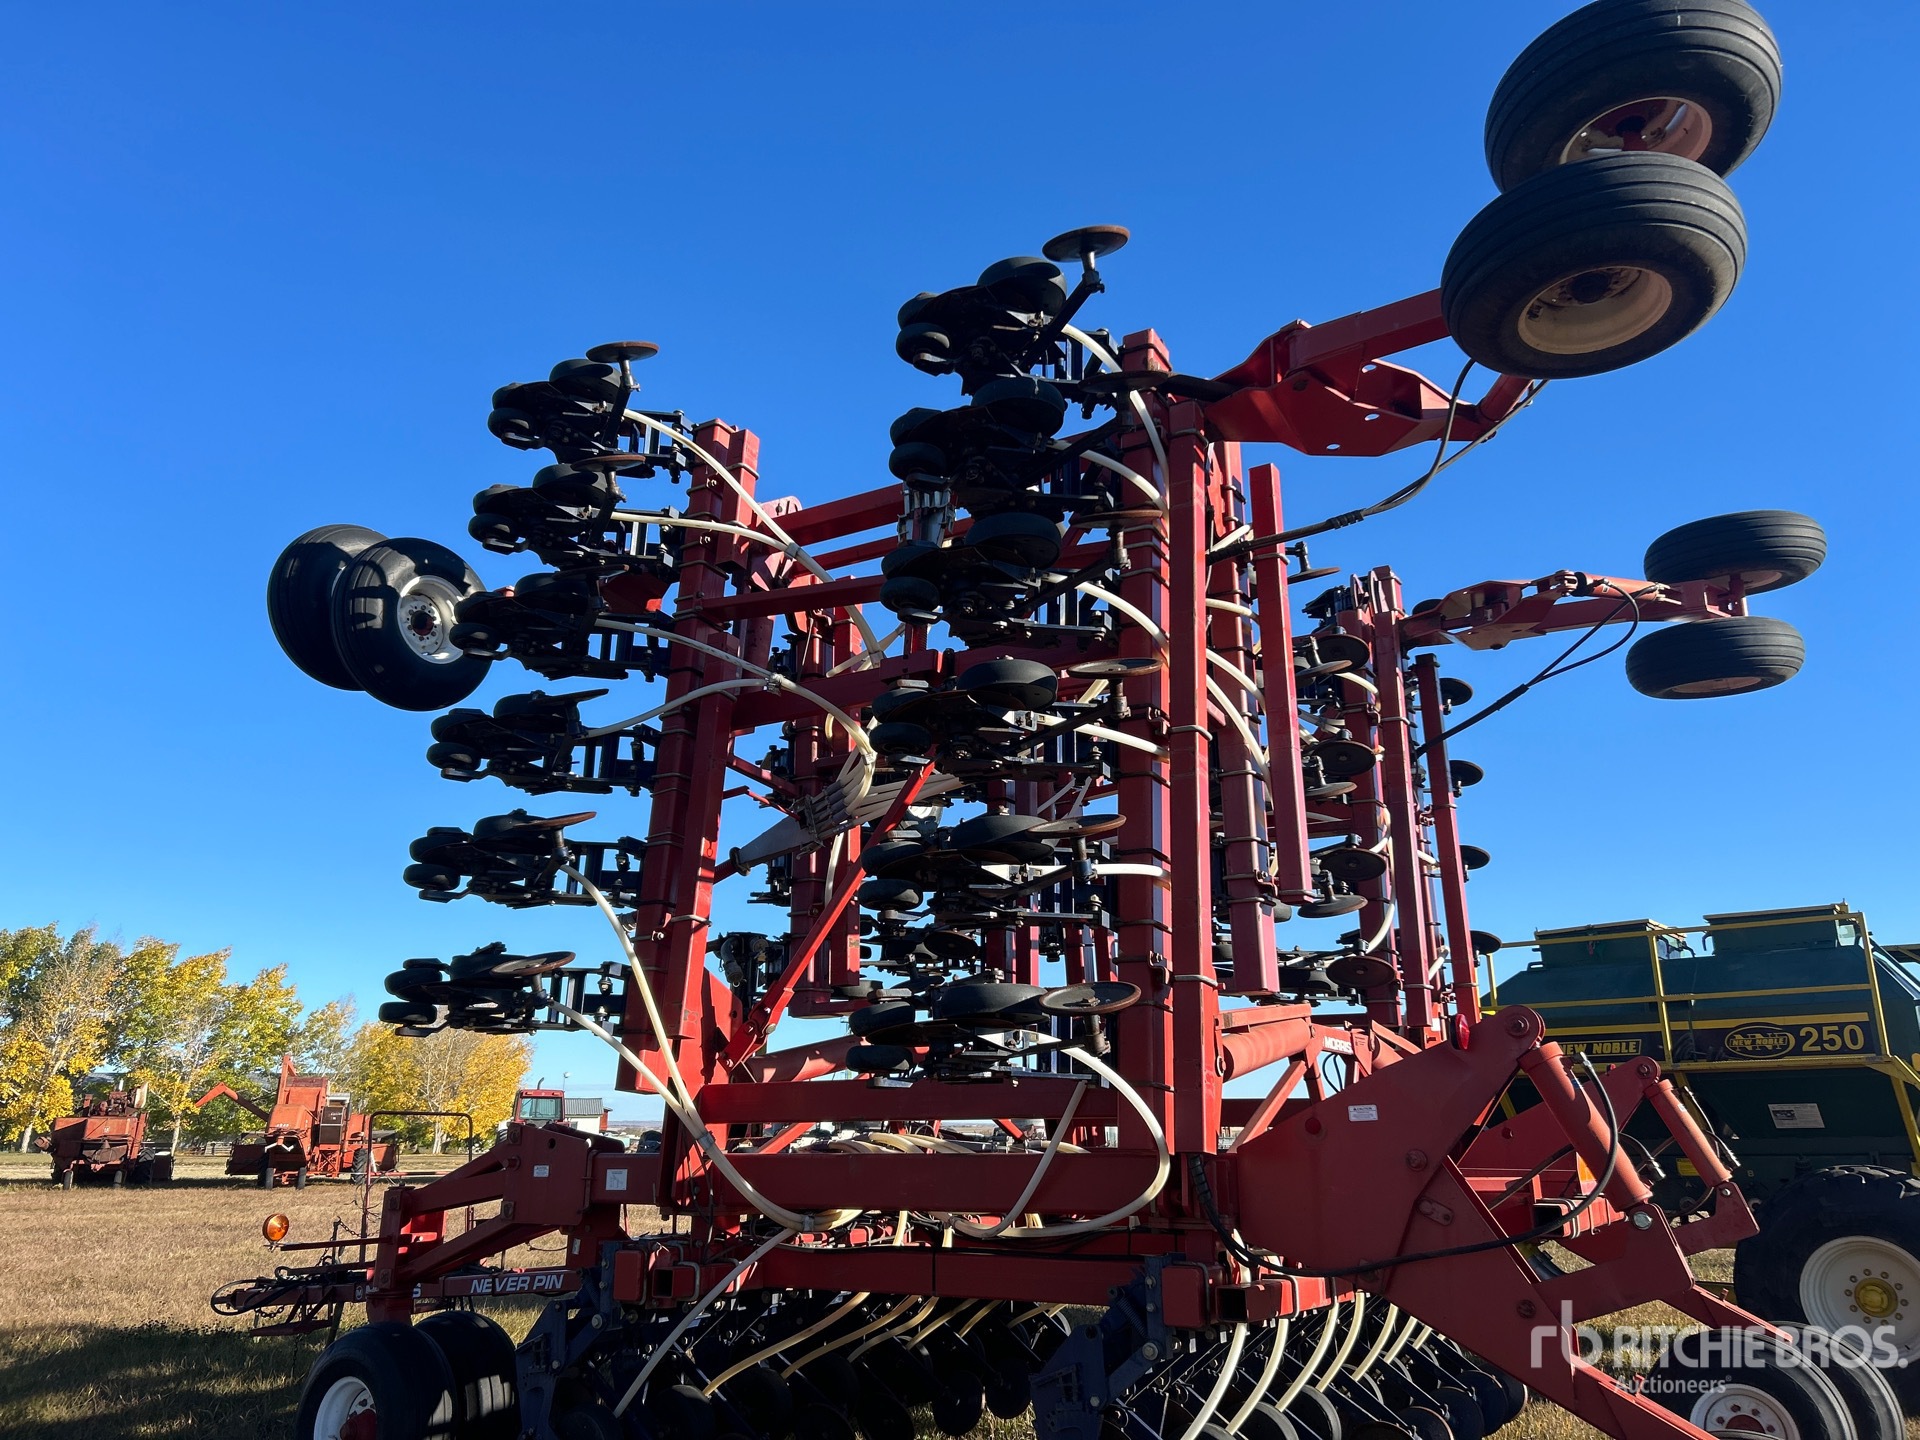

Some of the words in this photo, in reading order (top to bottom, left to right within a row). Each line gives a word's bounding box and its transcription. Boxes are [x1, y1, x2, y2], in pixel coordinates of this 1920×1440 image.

[1324, 1036, 1353, 1054] MORRIS
[1755, 1037, 1785, 1045] NOBLE
[1799, 1024, 1865, 1052] 250
[1592, 1041, 1637, 1055] NOBLE
[470, 1275, 531, 1294] NEVER
[532, 1274, 565, 1291] PIN
